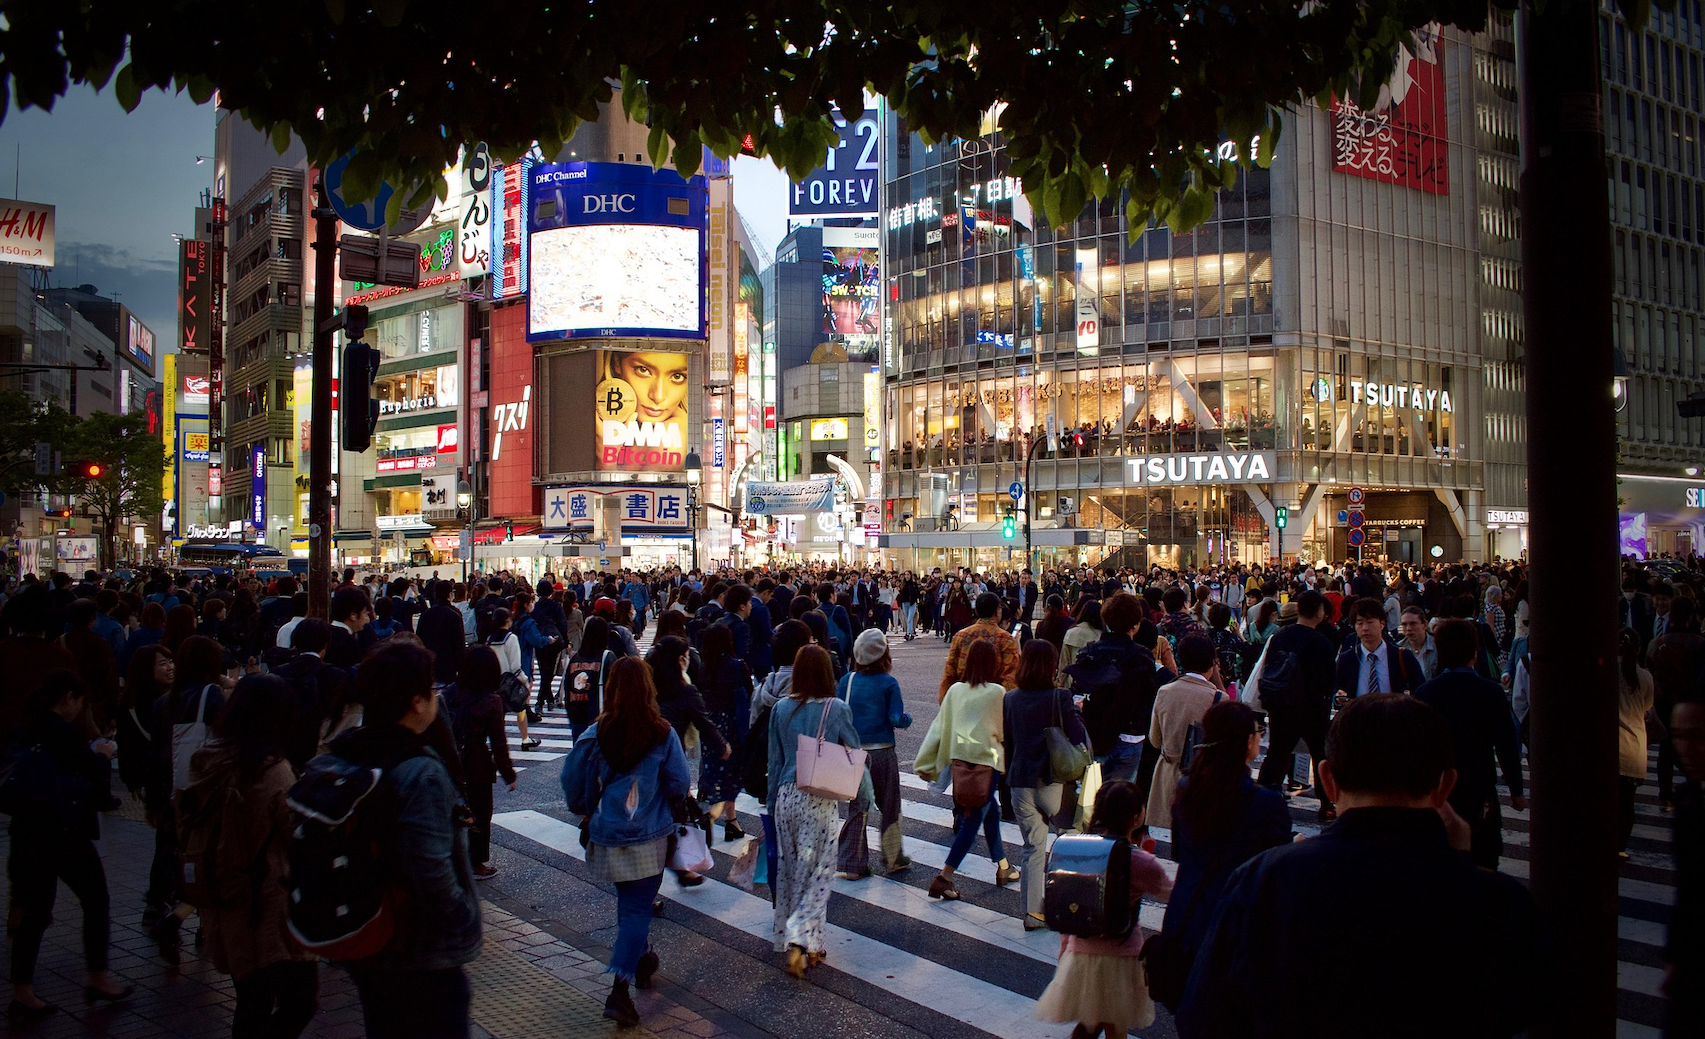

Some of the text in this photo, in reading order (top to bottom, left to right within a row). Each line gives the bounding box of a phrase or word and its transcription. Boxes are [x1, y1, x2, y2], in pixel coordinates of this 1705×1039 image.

[1335, 134, 1398, 179] 変える、
[1397, 151, 1445, 185] テレビ
[535, 168, 587, 184] DHC Channel
[583, 193, 636, 214] DHC
[0, 207, 48, 242] H&M
[197, 241, 206, 274] TOKYO
[711, 201, 726, 330] Taisei neon
[600, 328, 617, 336] DHC
[379, 393, 435, 414] Euphoria
[1350, 381, 1453, 413] TSUTAYA
[602, 419, 682, 448] DMM
[602, 446, 682, 466] Bitcoin
[1127, 454, 1270, 483] TSUTAYA
[550, 493, 681, 520] 大盛書店
[1488, 511, 1525, 522] TSUTAYA
